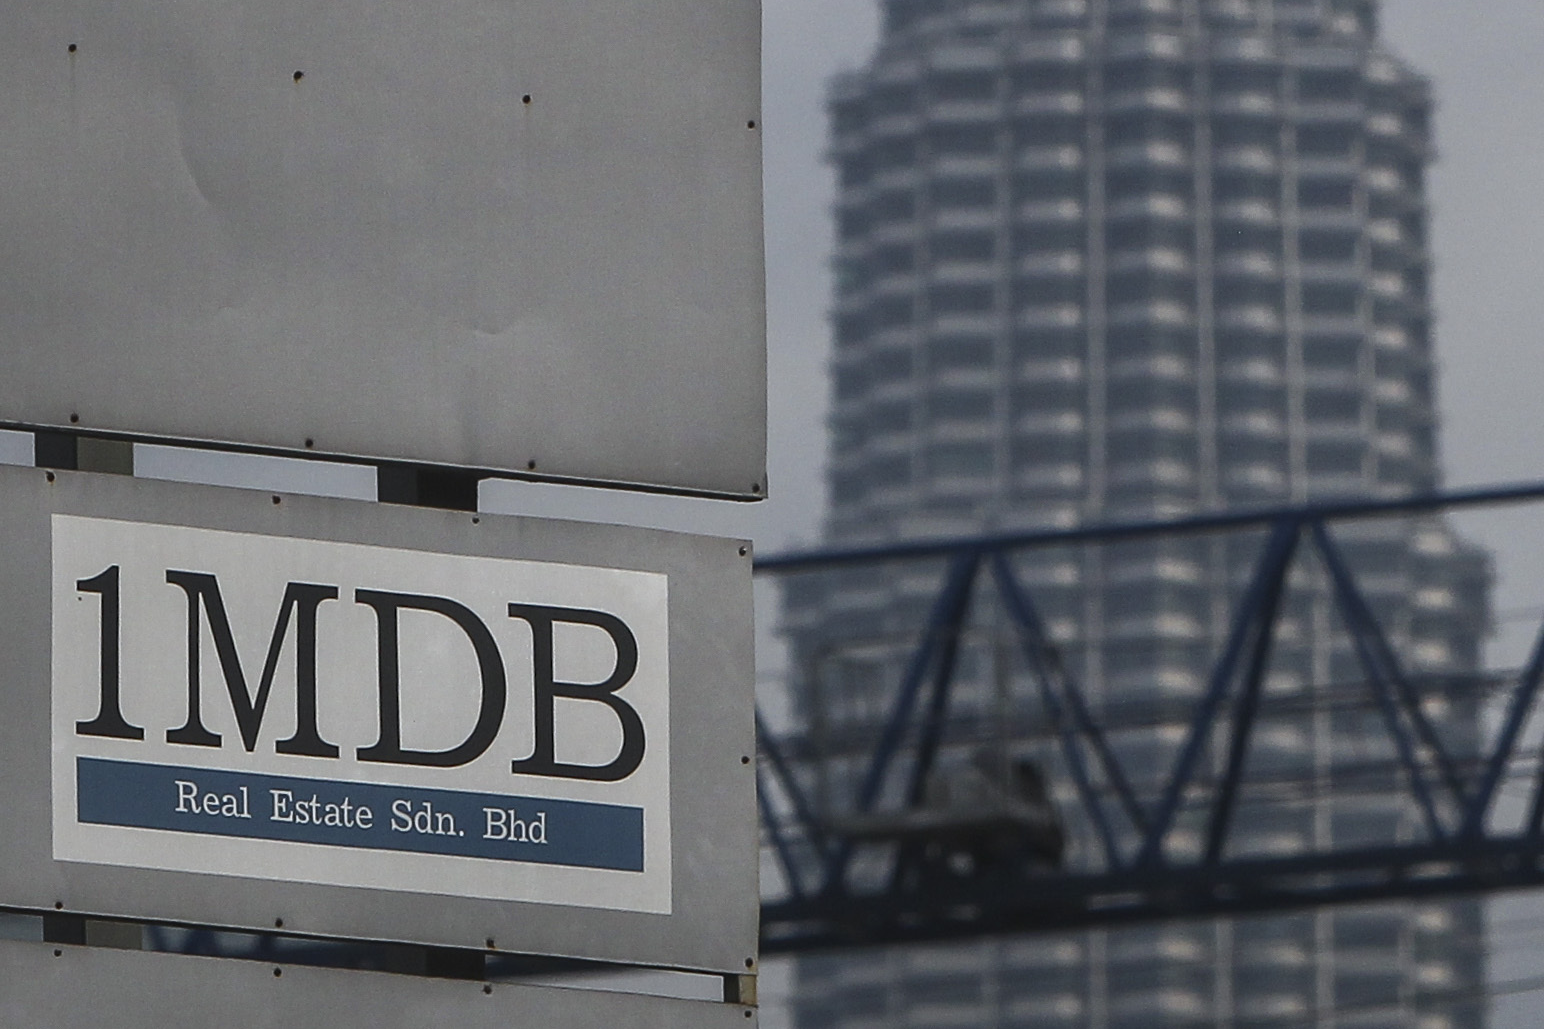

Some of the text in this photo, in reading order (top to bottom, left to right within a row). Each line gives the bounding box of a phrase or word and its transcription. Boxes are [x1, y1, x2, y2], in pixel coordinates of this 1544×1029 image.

[76, 565, 646, 781] 1MDB
[175, 781, 548, 844] Real Estate Sdn. Bhd
